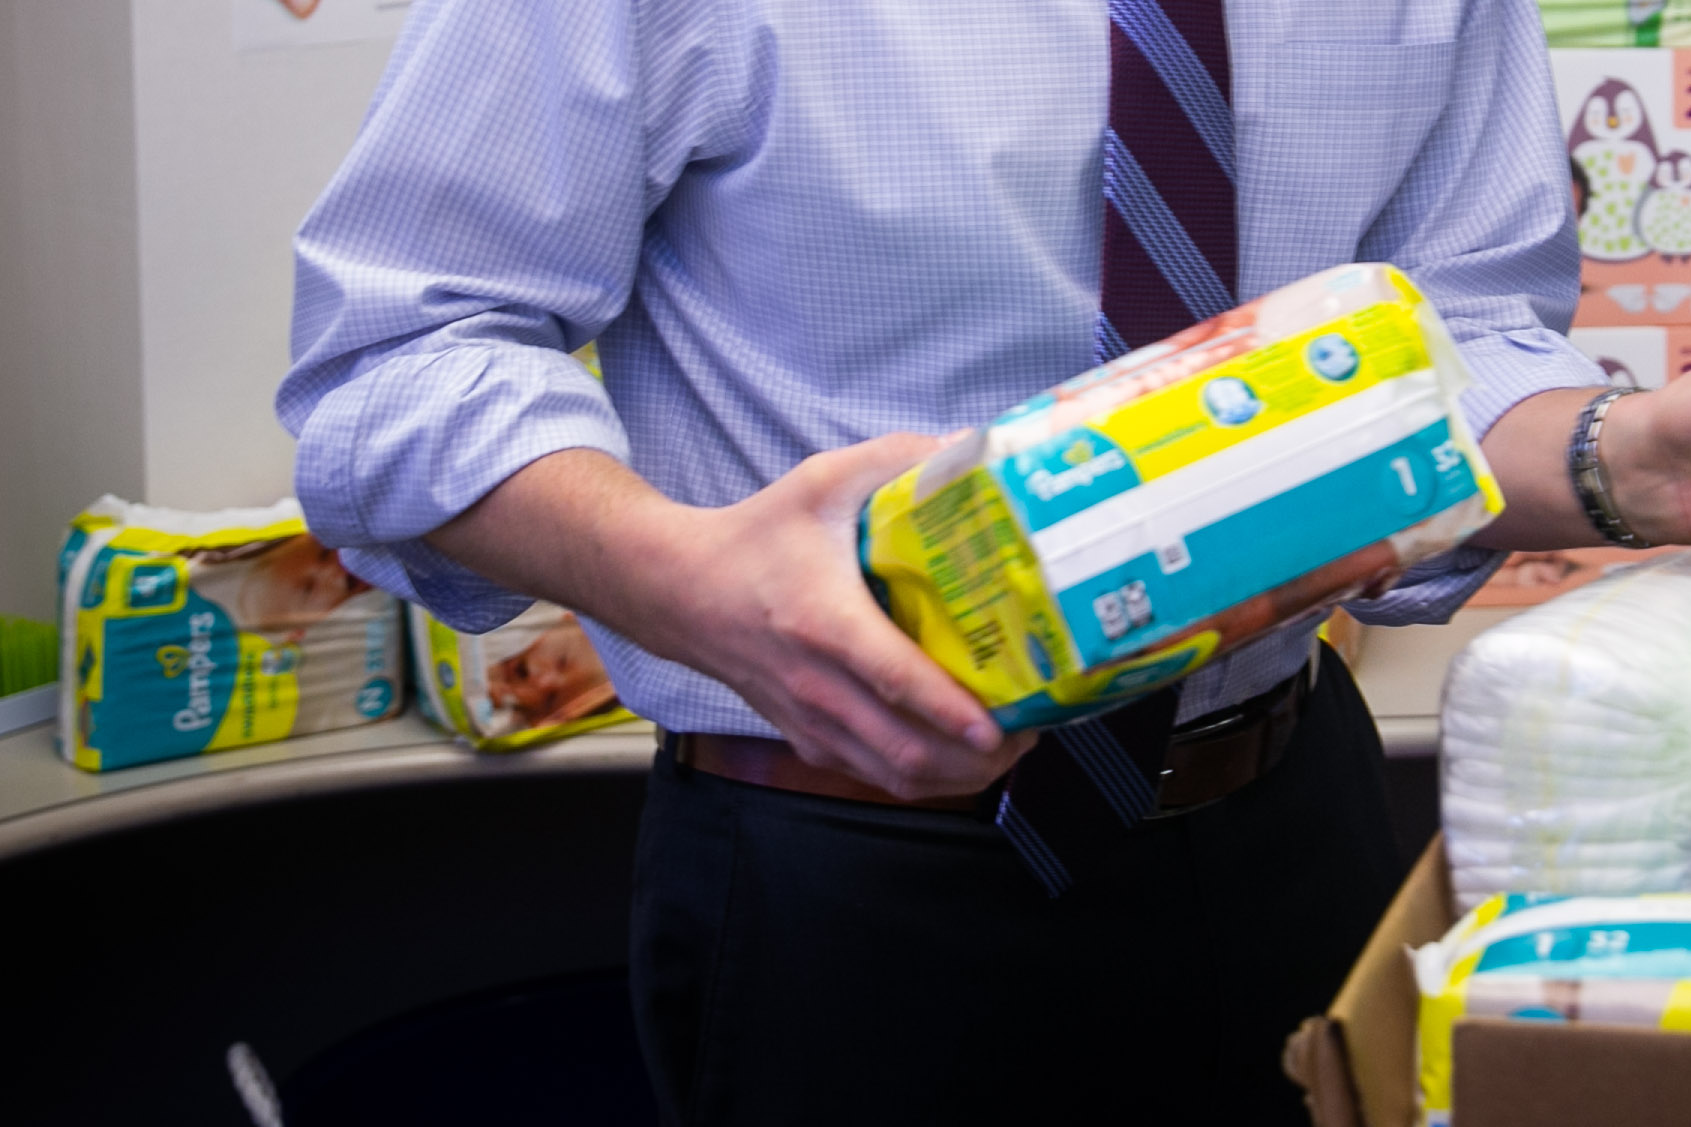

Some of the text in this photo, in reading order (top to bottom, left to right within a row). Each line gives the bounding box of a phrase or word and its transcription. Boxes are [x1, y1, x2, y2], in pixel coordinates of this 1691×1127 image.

[1389, 455, 1418, 497] 1
[172, 611, 217, 732] Pampers
[358, 685, 385, 712] N
